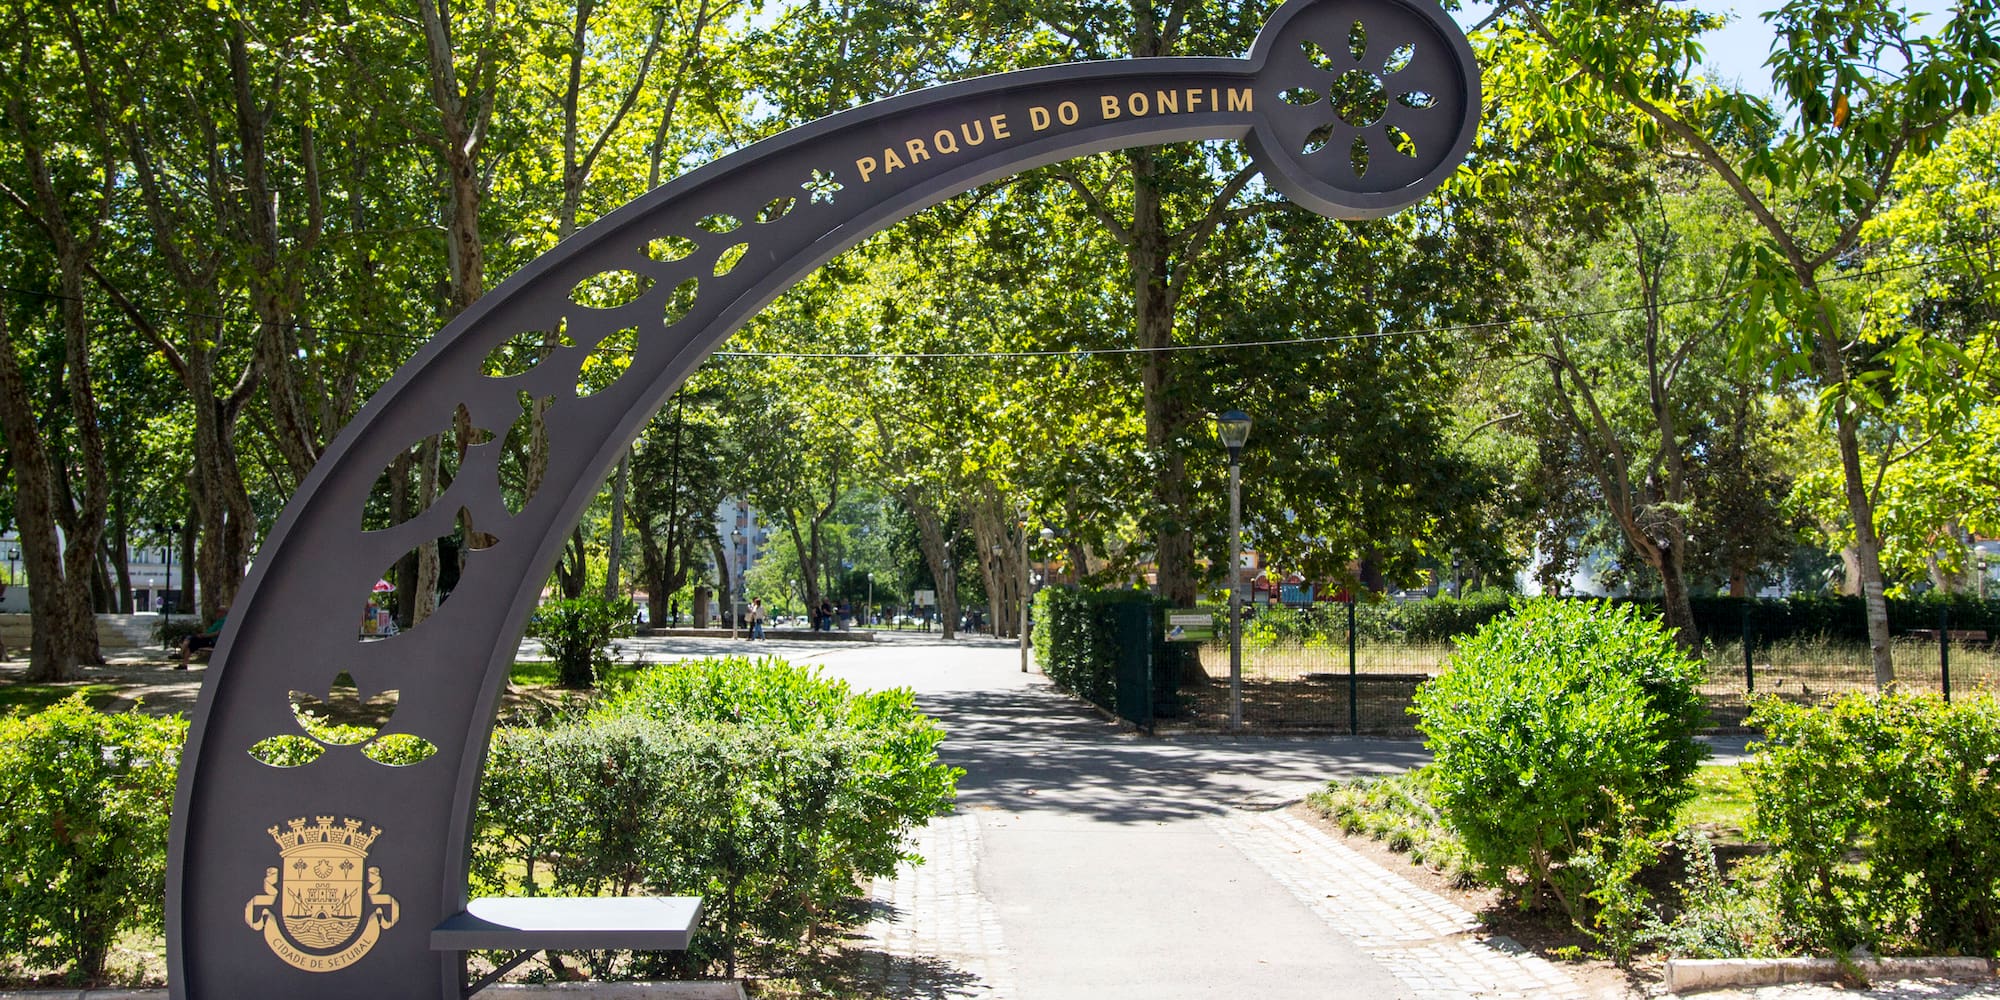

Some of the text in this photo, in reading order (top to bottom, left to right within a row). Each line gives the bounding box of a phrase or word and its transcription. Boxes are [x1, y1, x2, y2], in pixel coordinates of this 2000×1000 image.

[855, 87, 1253, 183] PARQUE DO BONFIM
[272, 937, 372, 969] CIDADE DE SETUBAL
